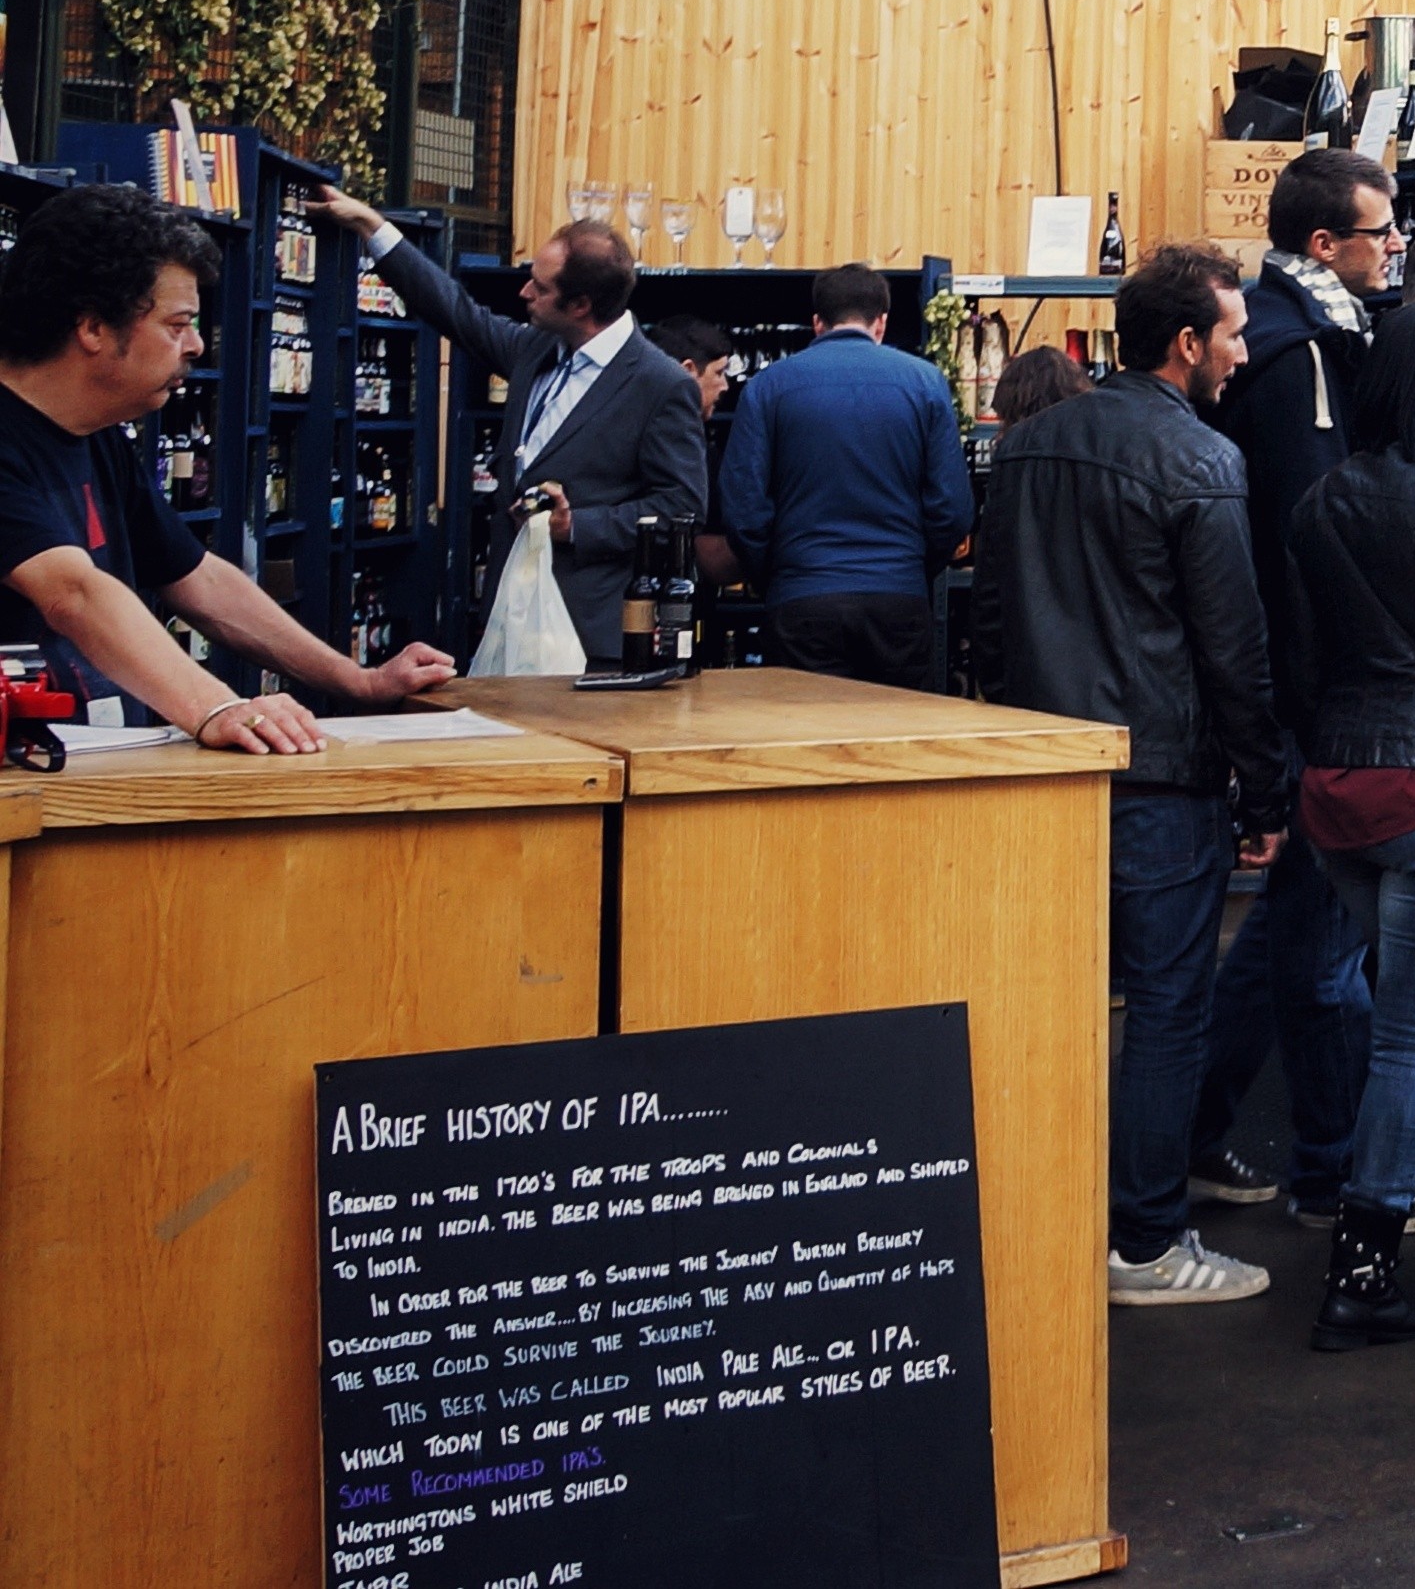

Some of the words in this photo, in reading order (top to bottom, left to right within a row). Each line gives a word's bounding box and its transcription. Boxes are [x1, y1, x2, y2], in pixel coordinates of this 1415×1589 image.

[332, 1106, 353, 1154] A
[360, 1104, 426, 1151] BRIEF
[447, 1100, 551, 1142] HISTORY
[562, 1097, 598, 1130] OF
[328, 1191, 397, 1216] BREWED
[412, 1192, 434, 1206] IN
[443, 1185, 479, 1202] THE
[497, 1171, 555, 1197] 1700'S
[572, 1166, 604, 1189] FOR
[610, 1163, 650, 1184] THE
[661, 1153, 726, 1179] TROOPS
[742, 1150, 779, 1169] AND
[788, 1138, 878, 1164] COLONIALS
[341, 1441, 404, 1472] WHICH
[424, 1430, 482, 1458] TODAY
[501, 1426, 520, 1445] IS
[533, 1420, 569, 1441] ONE
[581, 1413, 604, 1433] OF
[613, 1405, 650, 1426] THE
[665, 1397, 708, 1418] MOST
[718, 1386, 785, 1410] POPULAR
[801, 1371, 862, 1398] STYLES
[870, 1367, 891, 1389] OF
[383, 1402, 427, 1428] THIS
[441, 1393, 487, 1418] BEER
[498, 1386, 541, 1409] WAS
[551, 1374, 629, 1401] CALLED
[656, 1362, 704, 1387] INDIA
[722, 1349, 759, 1376] PALE
[827, 1340, 855, 1360] OR
[336, 1505, 476, 1545] WORTHINGTONS
[491, 1489, 553, 1517] WHITE
[564, 1474, 628, 1503] SHIELD
[333, 1543, 395, 1574] PROPER
[408, 1534, 444, 1556] JOB
